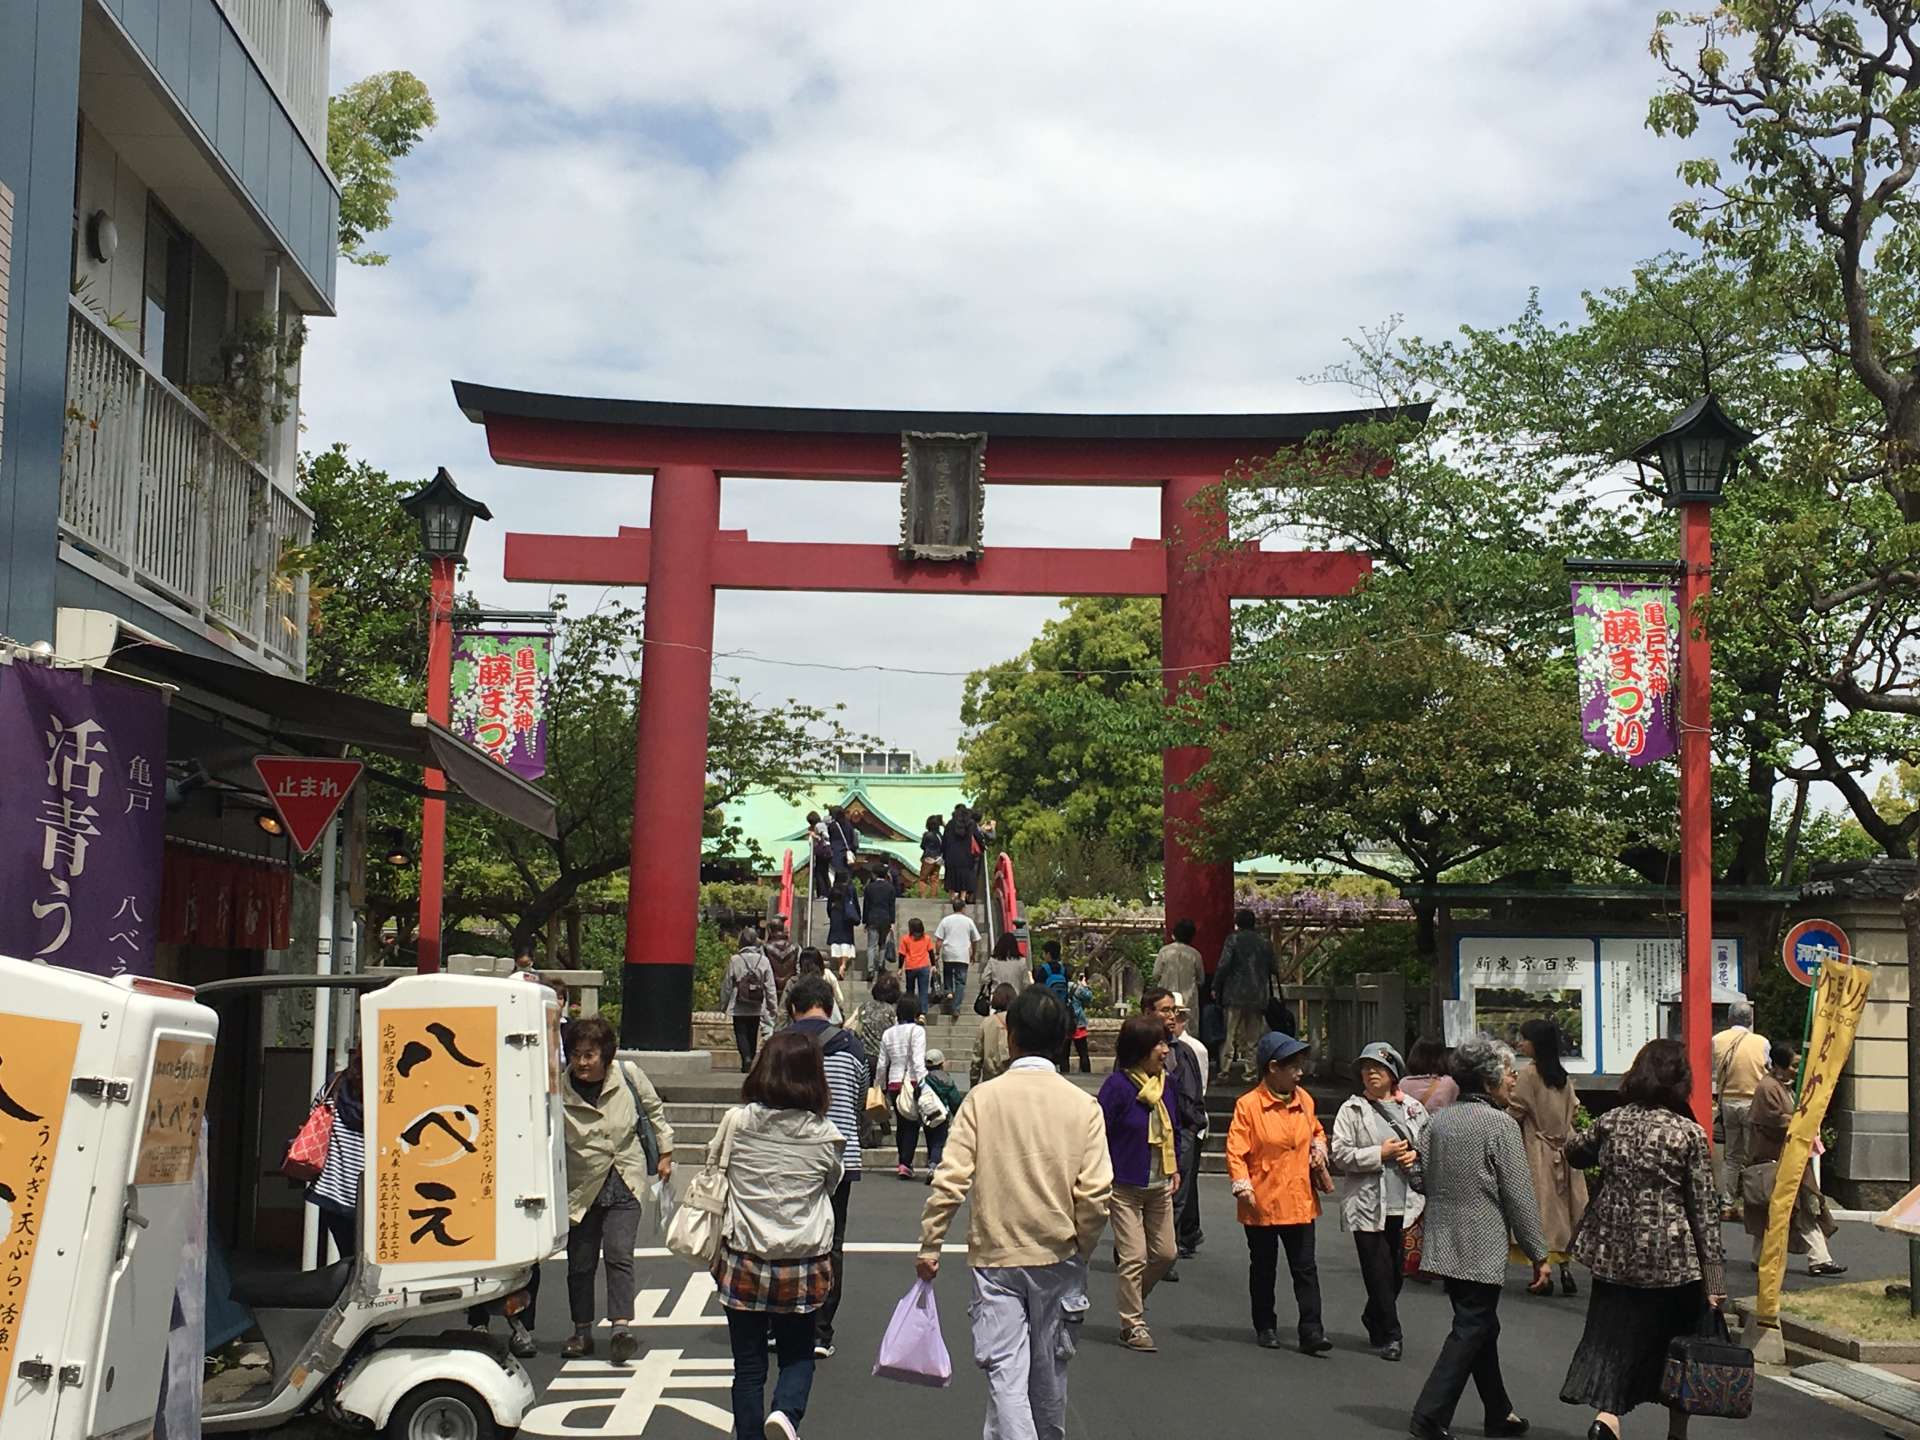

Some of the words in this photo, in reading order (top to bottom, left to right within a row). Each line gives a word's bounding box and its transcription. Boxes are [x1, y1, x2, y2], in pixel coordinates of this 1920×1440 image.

[512, 647, 537, 732] 亀戸天神
[1602, 608, 1646, 757] 藤まつり
[1643, 602, 1669, 698] 亀戸天神
[124, 755, 153, 815] 亀戸
[275, 774, 342, 800] 止まれ
[31, 713, 109, 967] 活青う
[1475, 956, 1580, 972] 新東京百景
[396, 1022, 486, 1247] 八べえ
